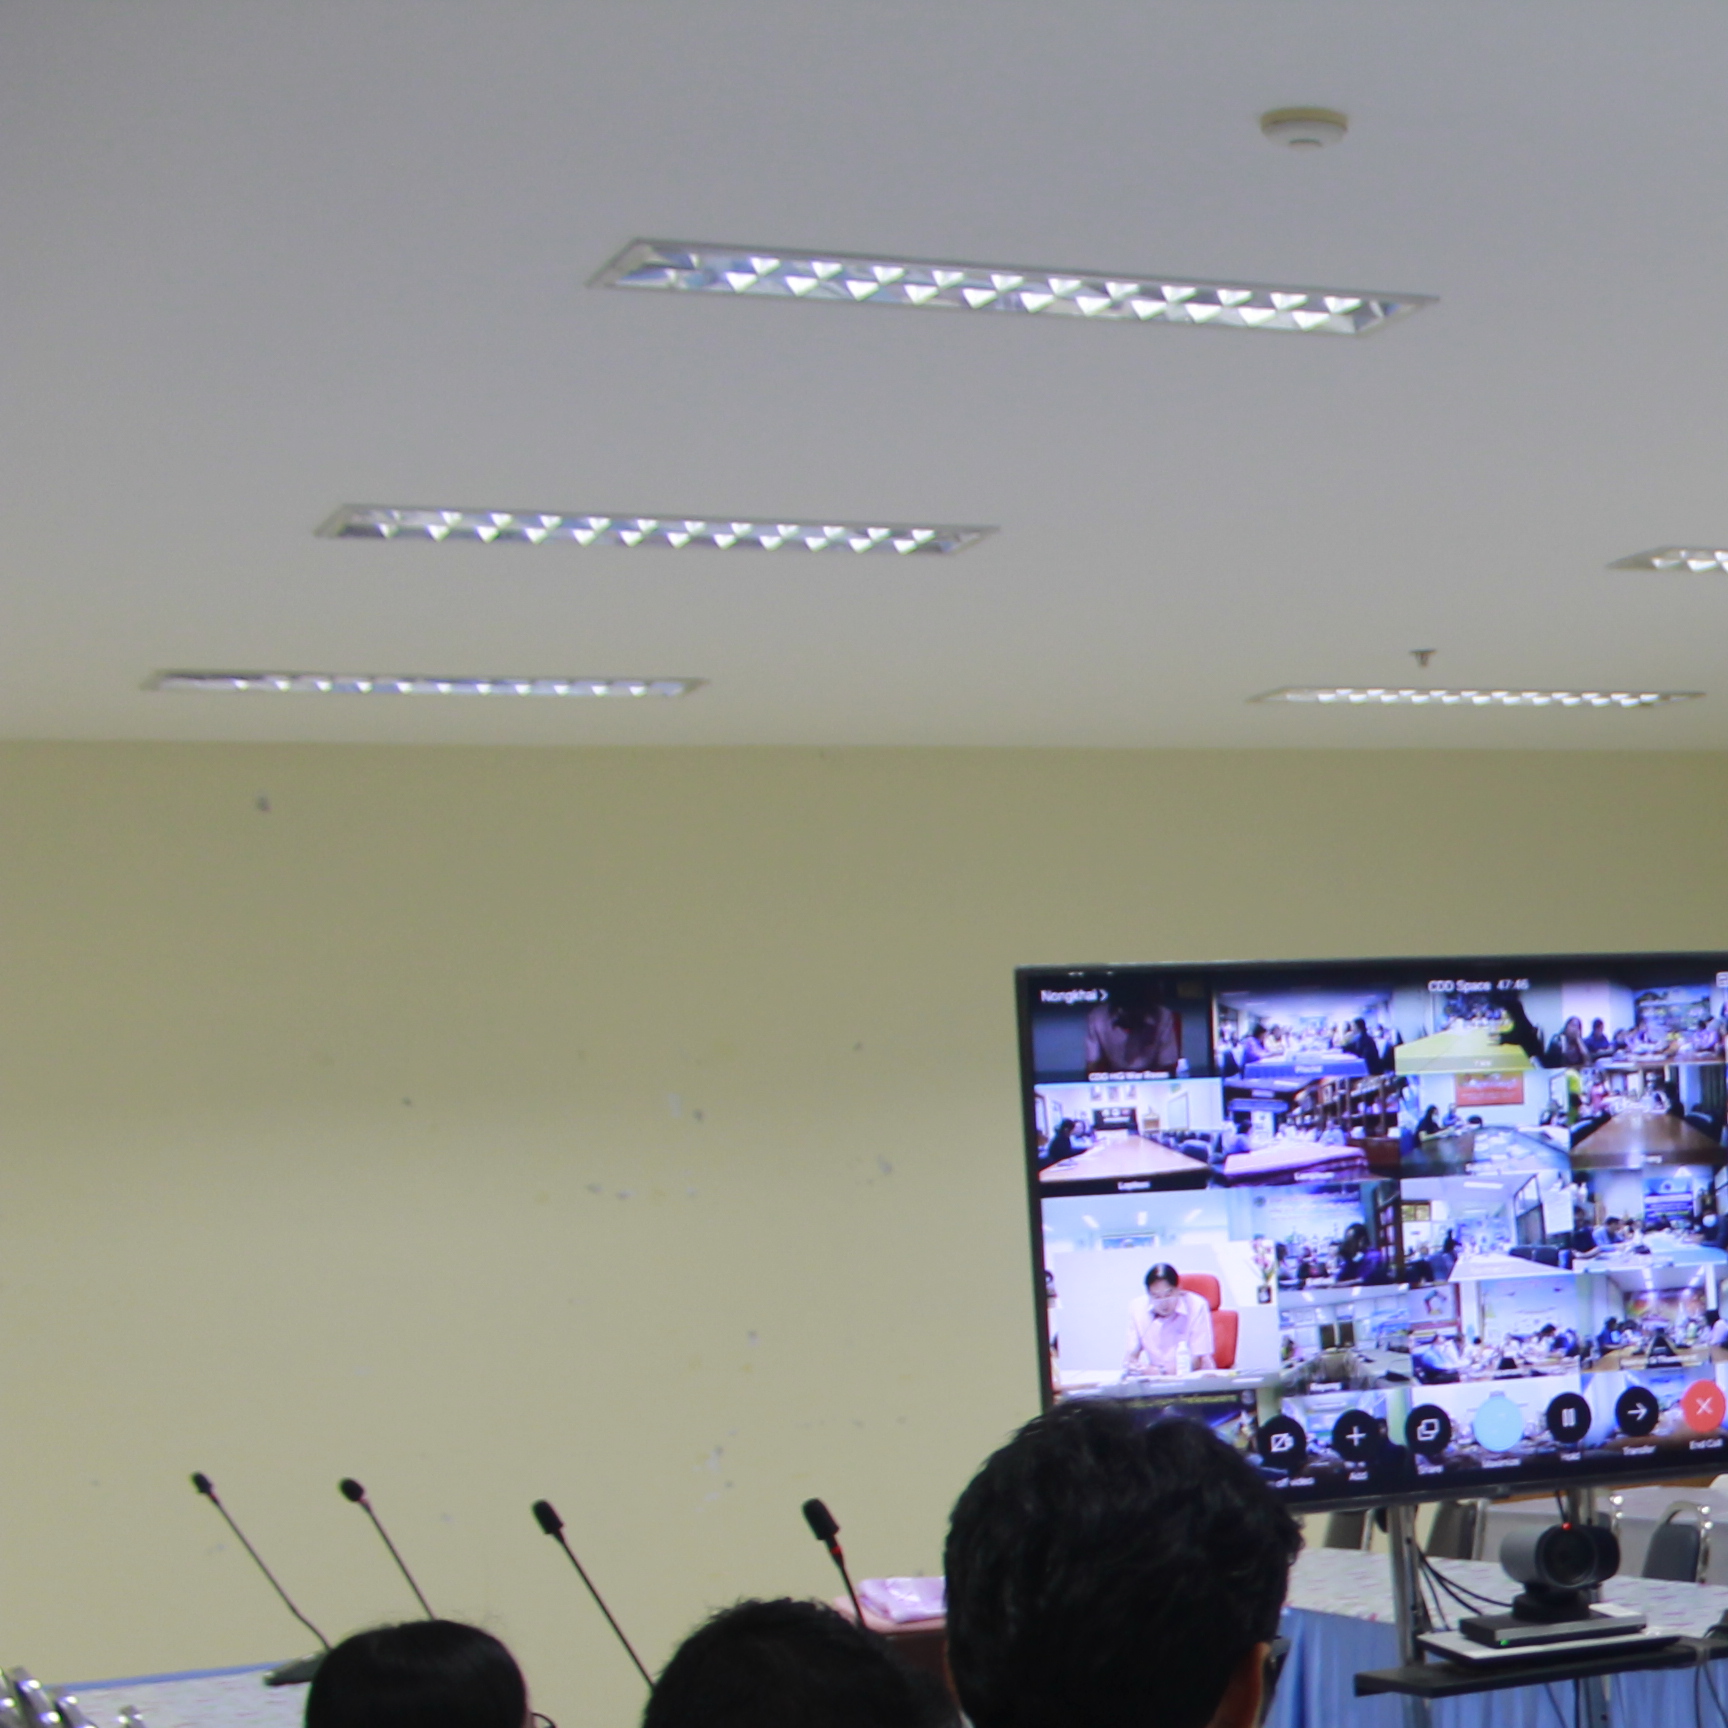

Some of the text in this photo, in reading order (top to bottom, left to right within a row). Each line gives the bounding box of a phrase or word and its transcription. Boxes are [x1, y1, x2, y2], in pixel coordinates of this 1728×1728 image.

[1456, 979, 1492, 994] Space
[1041, 988, 1097, 1004] Nongkhai
[1690, 1438, 1723, 1450] End Call
[1623, 1445, 1657, 1456] Transfer
[1349, 1471, 1368, 1481] Add
